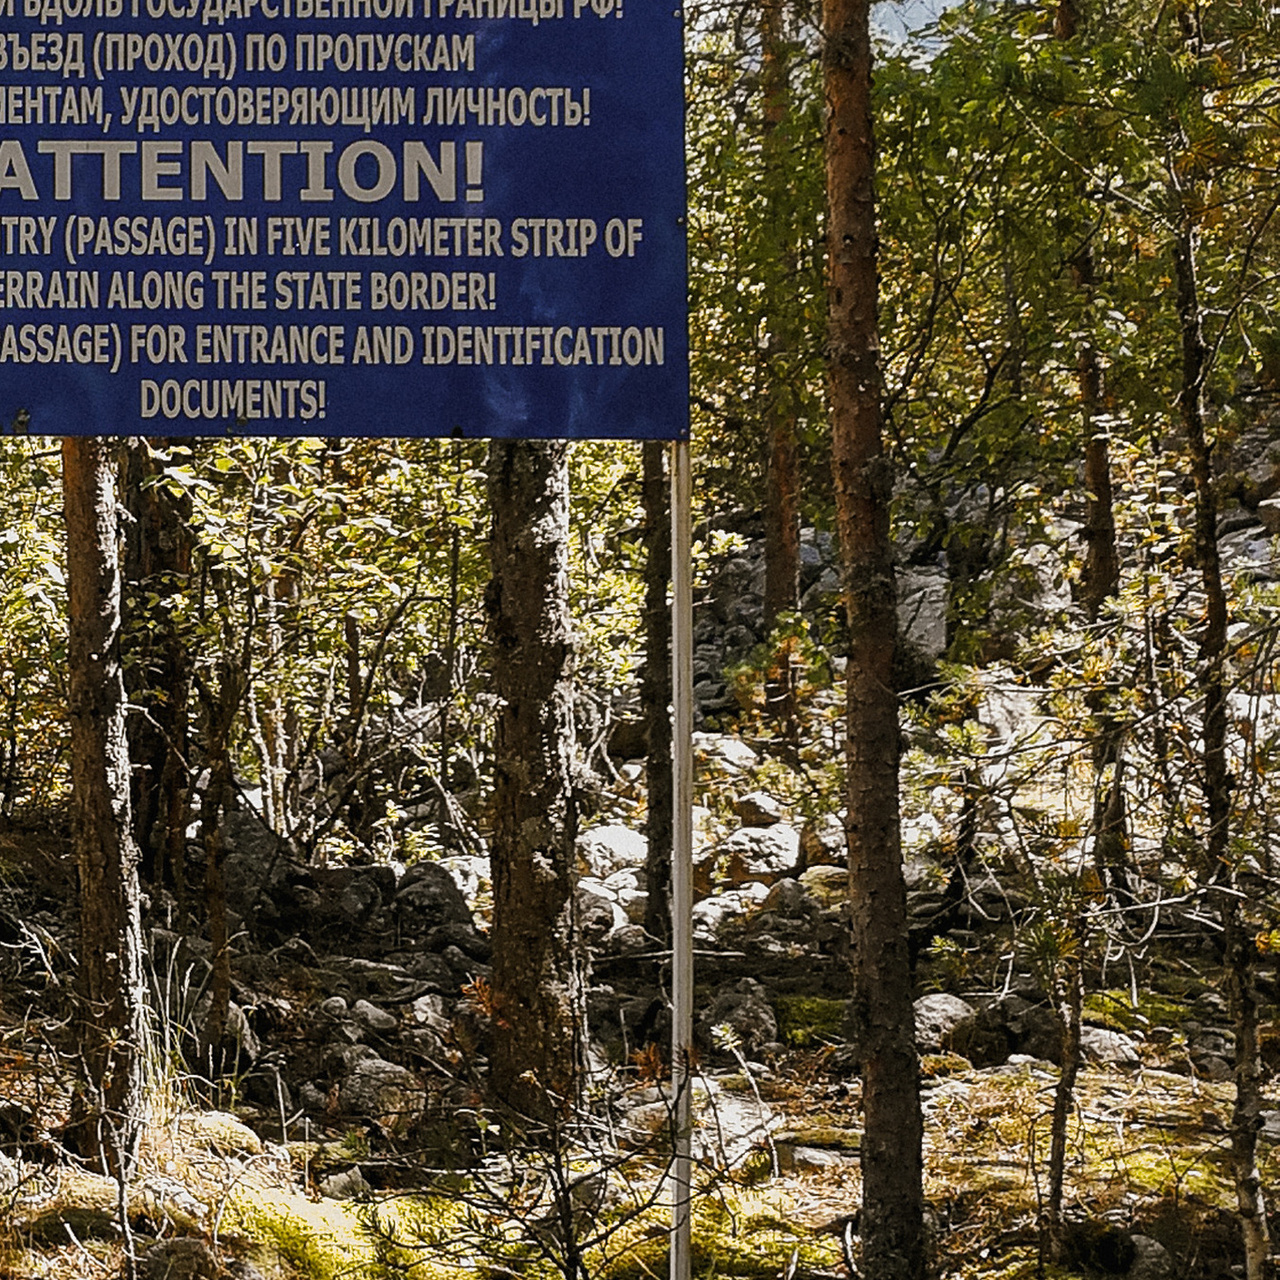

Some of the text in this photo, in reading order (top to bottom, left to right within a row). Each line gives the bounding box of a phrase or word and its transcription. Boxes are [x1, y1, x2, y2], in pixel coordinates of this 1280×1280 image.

[94, 33, 236, 80] (ПРОХОД)
[247, 34, 286, 71] ПО
[297, 34, 474, 71] ПРОПУСКАМ
[121, 87, 414, 132] УДОСТОВЕРЯЮЩИМ
[424, 88, 590, 125] ЛИЧНОСТЬ!
[66, 215, 215, 265] (PASSAGE)
[225, 218, 257, 255] IN
[268, 218, 330, 255] FIVE
[340, 217, 503, 256] KILOMETER
[512, 218, 596, 257] STRIP
[606, 219, 642, 257] OF
[108, 271, 203, 309] ALONG
[212, 272, 266, 309] THE
[276, 272, 361, 309] STATE
[371, 272, 496, 310] BORDER!
[132, 325, 187, 363] FOR
[197, 325, 344, 364] ENTRANCE
[353, 326, 413, 364] AND
[423, 327, 663, 365] IDENTIFICATION
[142, 380, 325, 419] DOCUMENTS!
